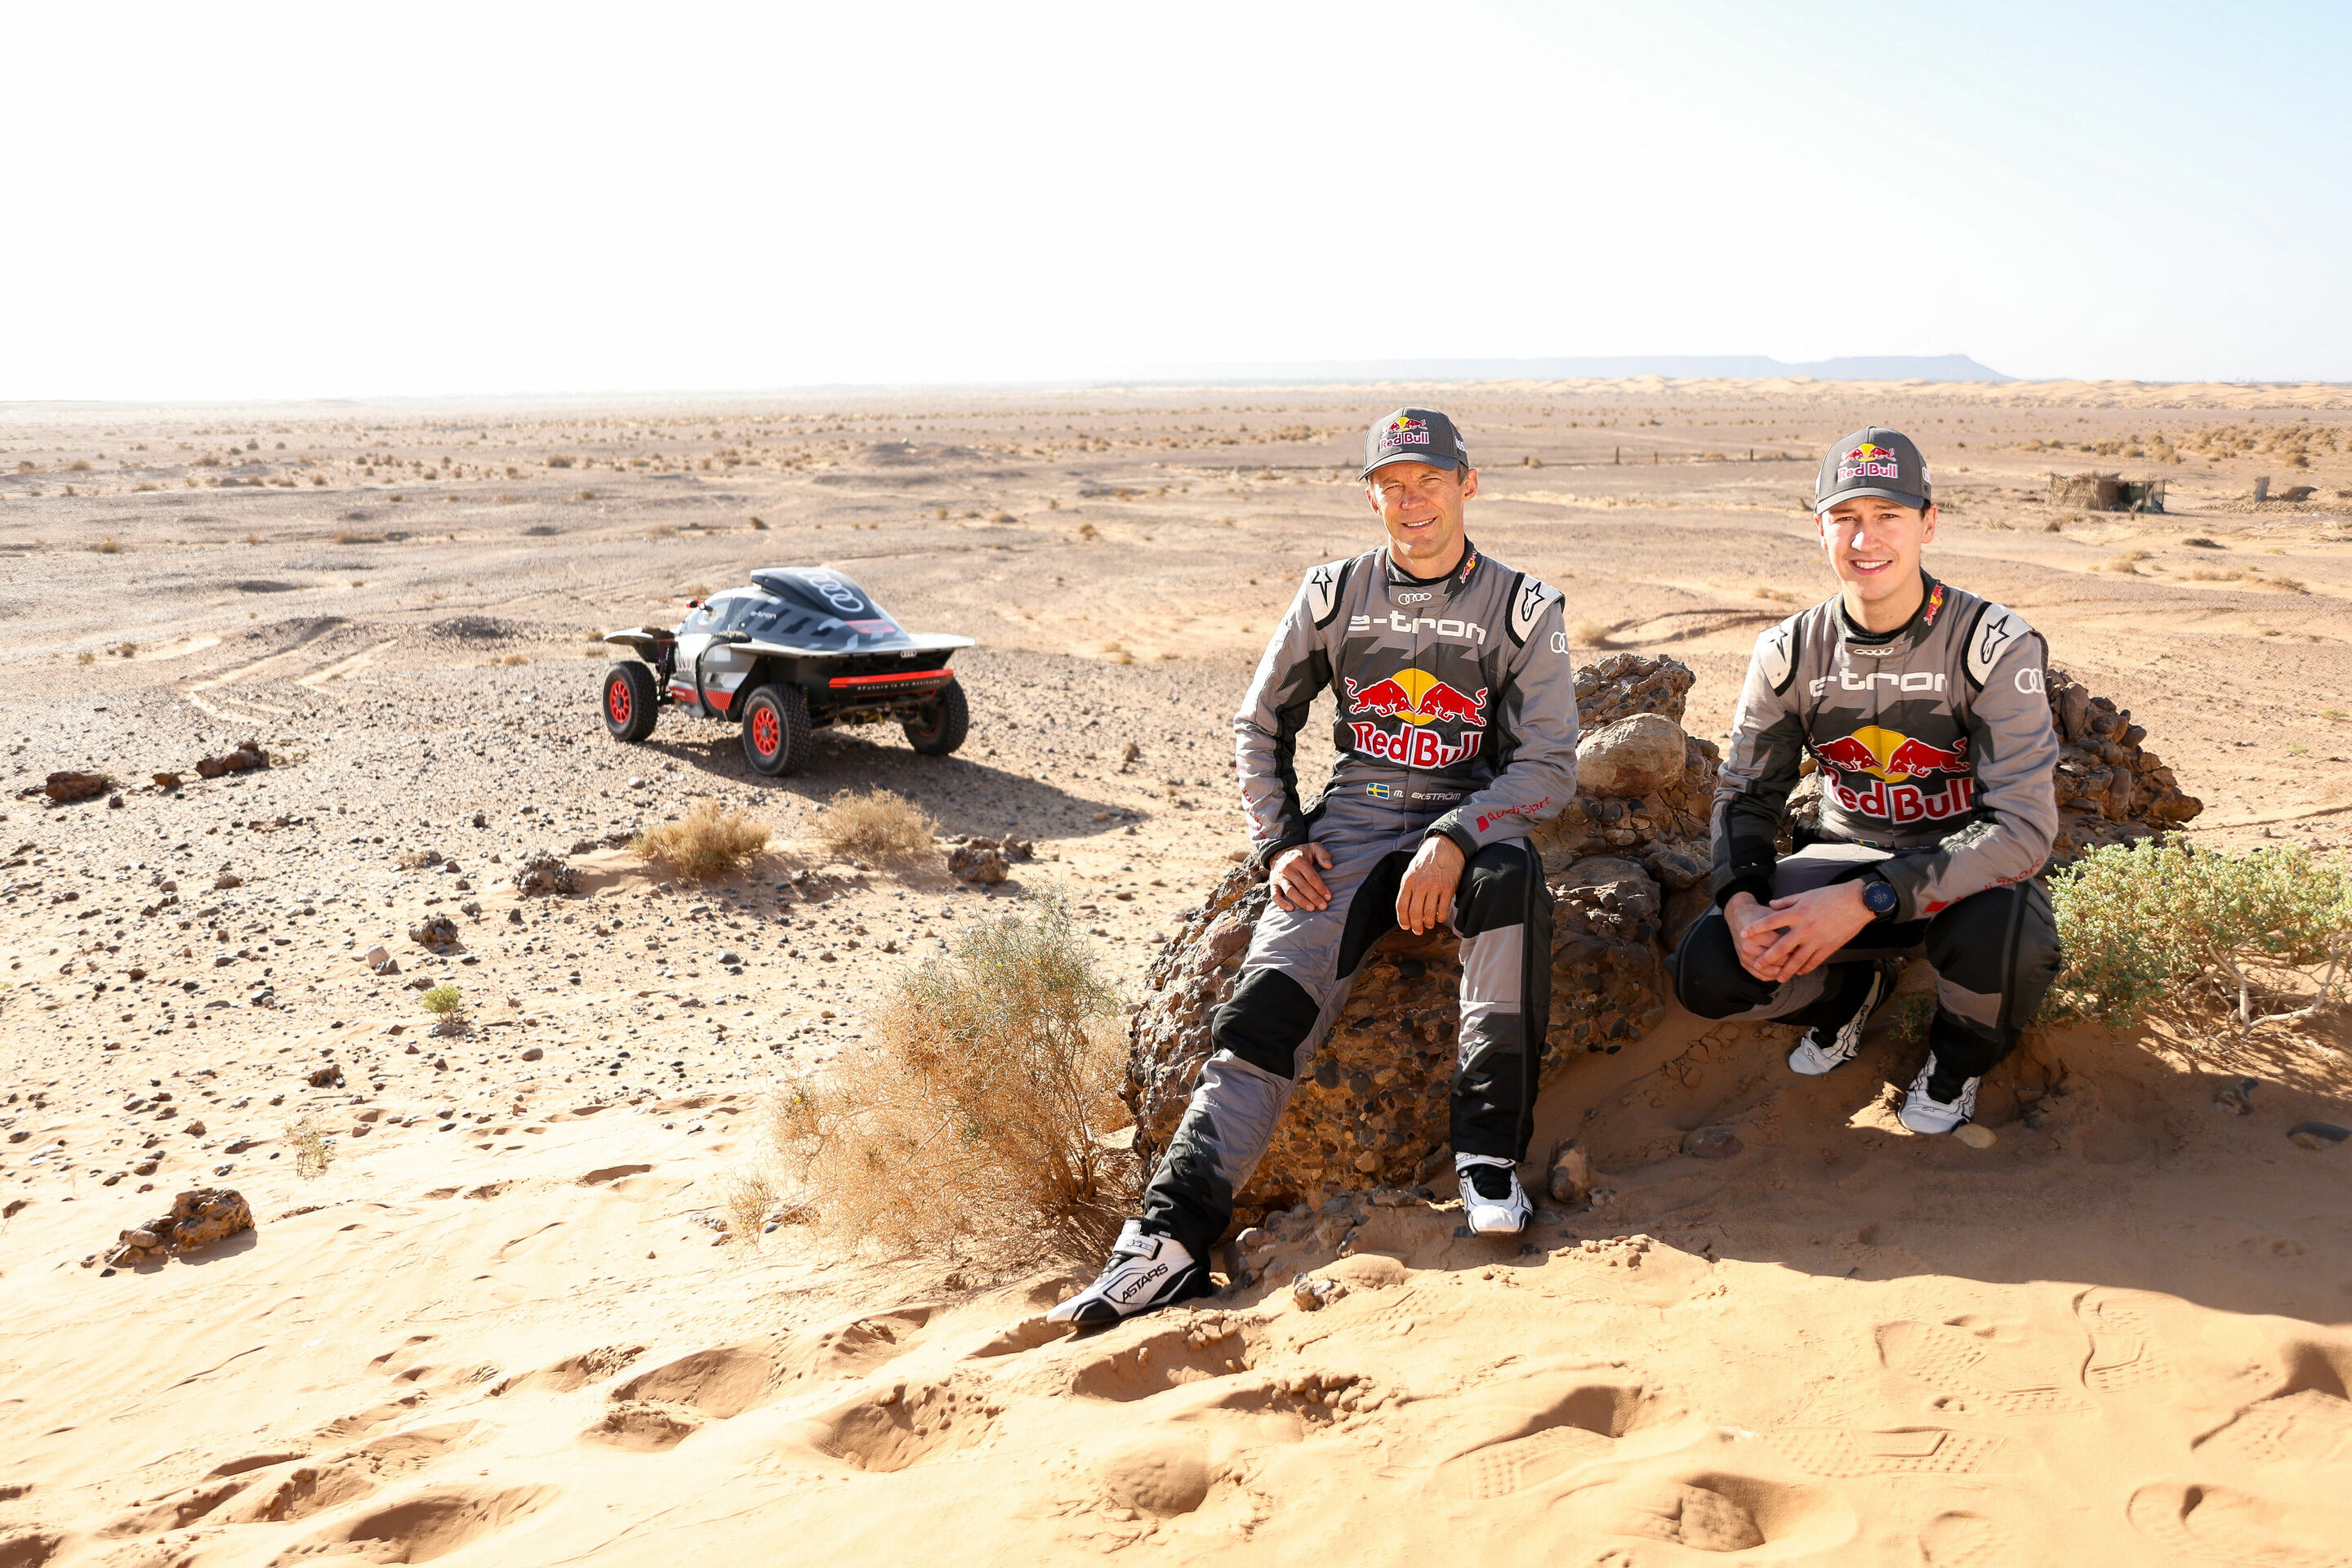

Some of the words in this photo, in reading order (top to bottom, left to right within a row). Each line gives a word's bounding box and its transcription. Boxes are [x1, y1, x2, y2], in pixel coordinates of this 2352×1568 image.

[1379, 432, 1402, 451] Red
[1404, 431, 1429, 444] Bull
[1838, 462, 1866, 482] Red
[1868, 462, 1898, 479] Bull
[1348, 722, 1414, 765] Red
[1410, 728, 1483, 769] Bull
[1410, 791, 1461, 800] EKSTRÖM
[1819, 764, 1889, 818] Red
[1887, 777, 1975, 825] Bull
[1487, 805, 1521, 822] Audi
[1122, 1263, 1169, 1304] ASTARS
